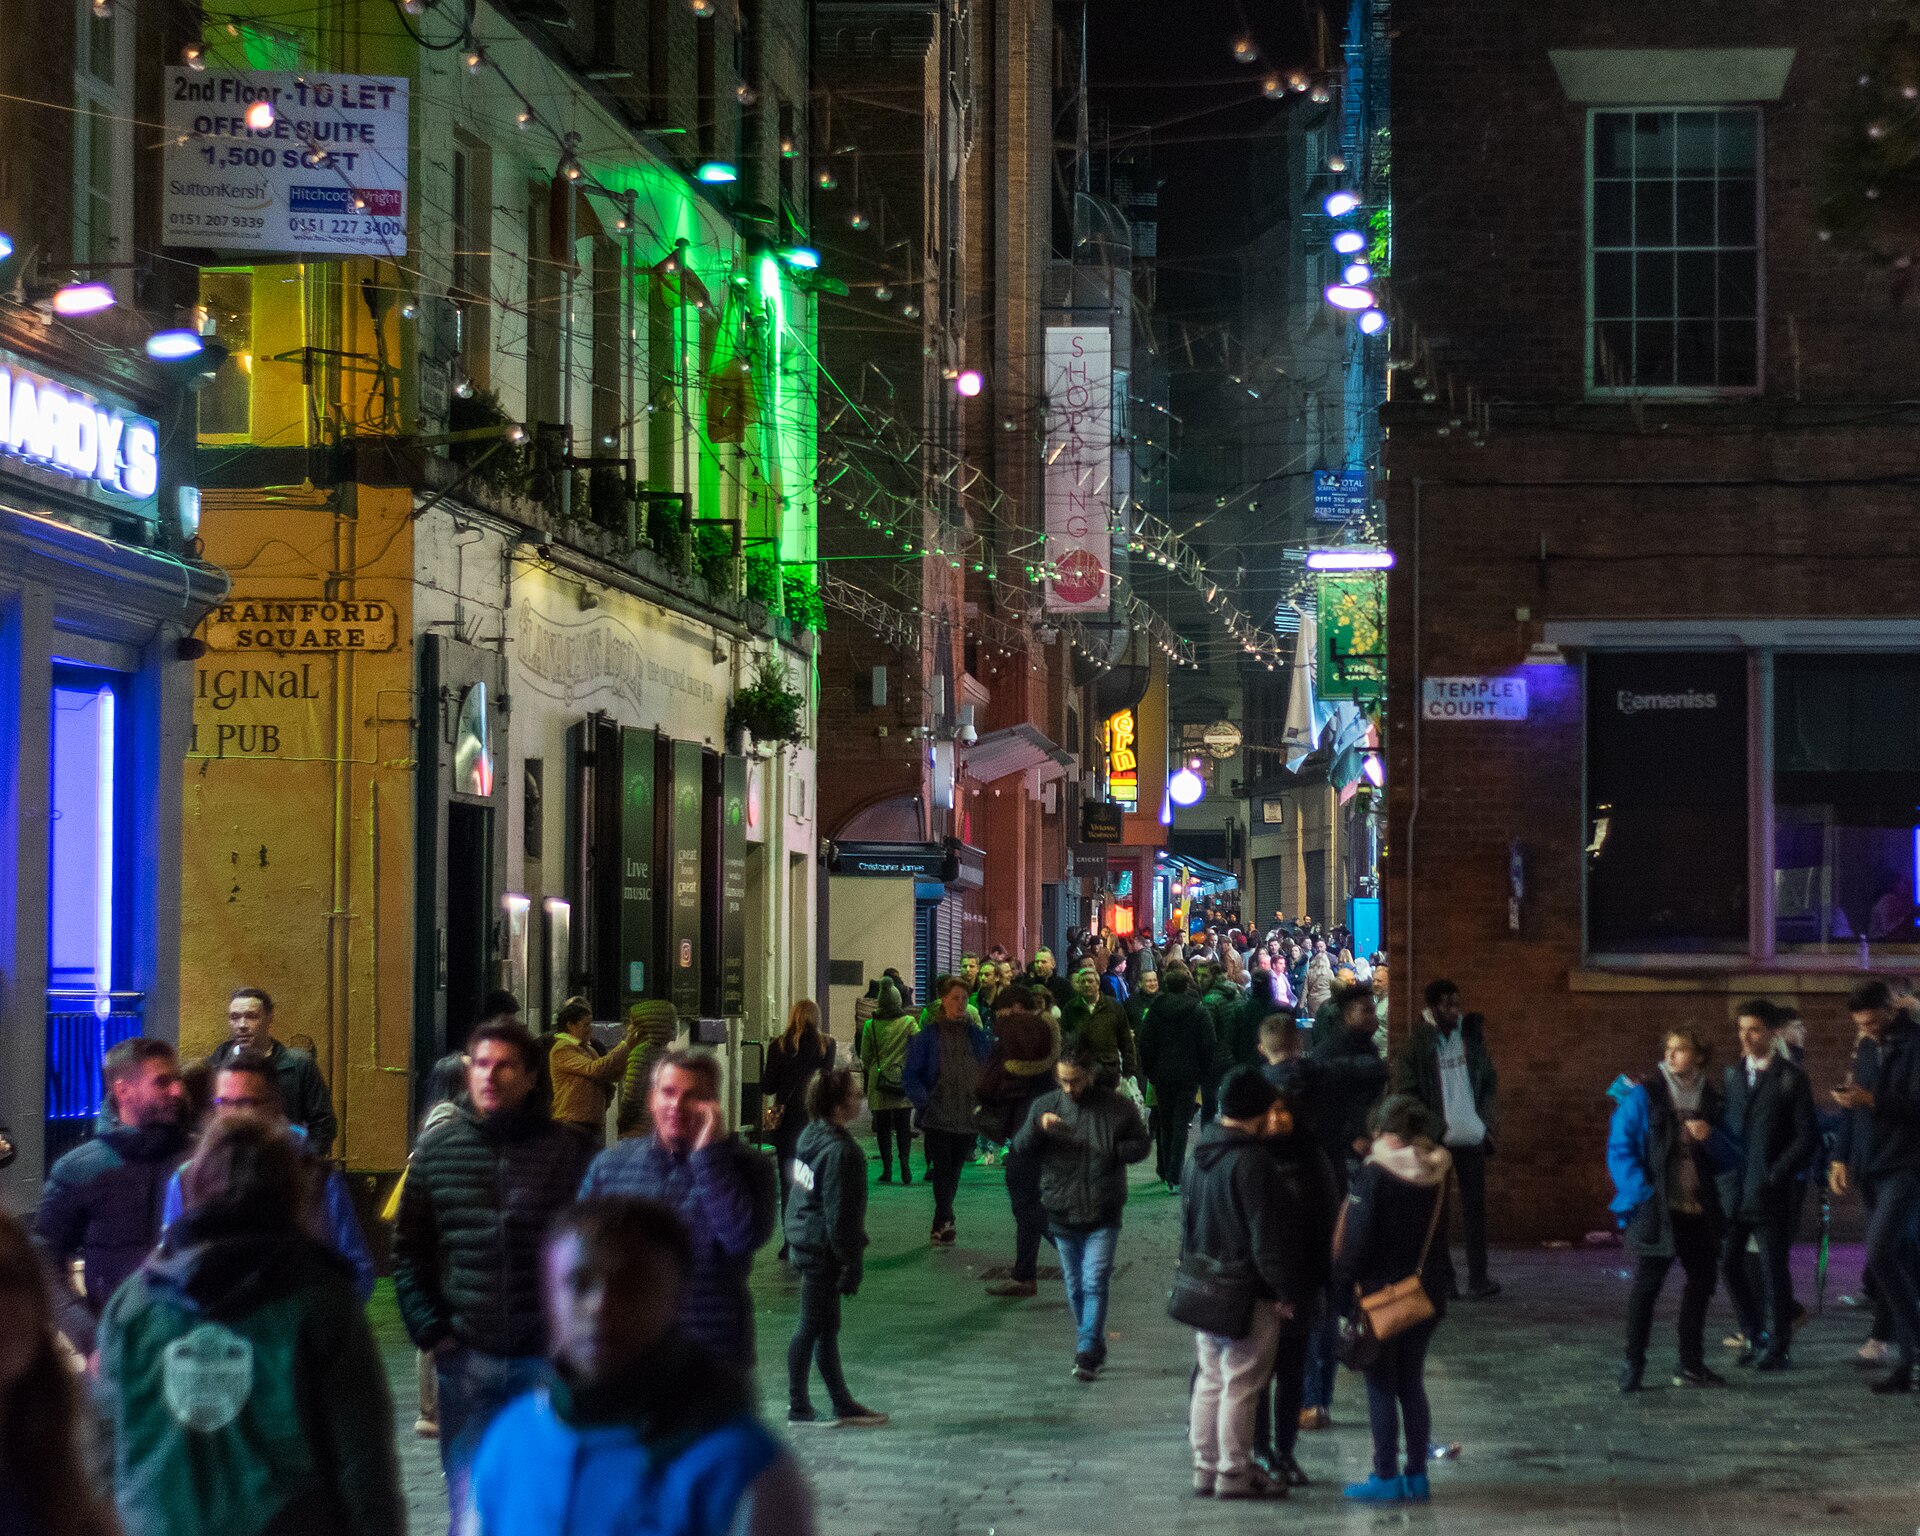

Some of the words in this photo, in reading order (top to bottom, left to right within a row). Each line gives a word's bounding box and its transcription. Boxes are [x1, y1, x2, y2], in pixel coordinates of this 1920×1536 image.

[174, 76, 215, 101] 2nd
[220, 78, 282, 105] Floor
[294, 82, 334, 108] TO
[341, 84, 397, 111] LET
[296, 120, 375, 144] SUITE
[203, 146, 277, 169] 1,500
[169, 180, 266, 200] SuttonKersh
[291, 188, 354, 202] Hitchcock
[169, 213, 200, 225] 0151
[205, 215, 229, 227] 207
[232, 216, 265, 229] 9339
[289, 218, 324, 232] 0151
[331, 219, 359, 234] 227
[363, 221, 401, 236] 3400
[1066, 335, 1089, 538] SHOPPING
[1340, 479, 1364, 488] OTAL
[216, 603, 385, 624] RAINFORD
[237, 628, 366, 648] SQUARE
[1436, 682, 1514, 698] TEMPLE
[1429, 701, 1496, 717] COURT
[216, 724, 281, 760] PUB
